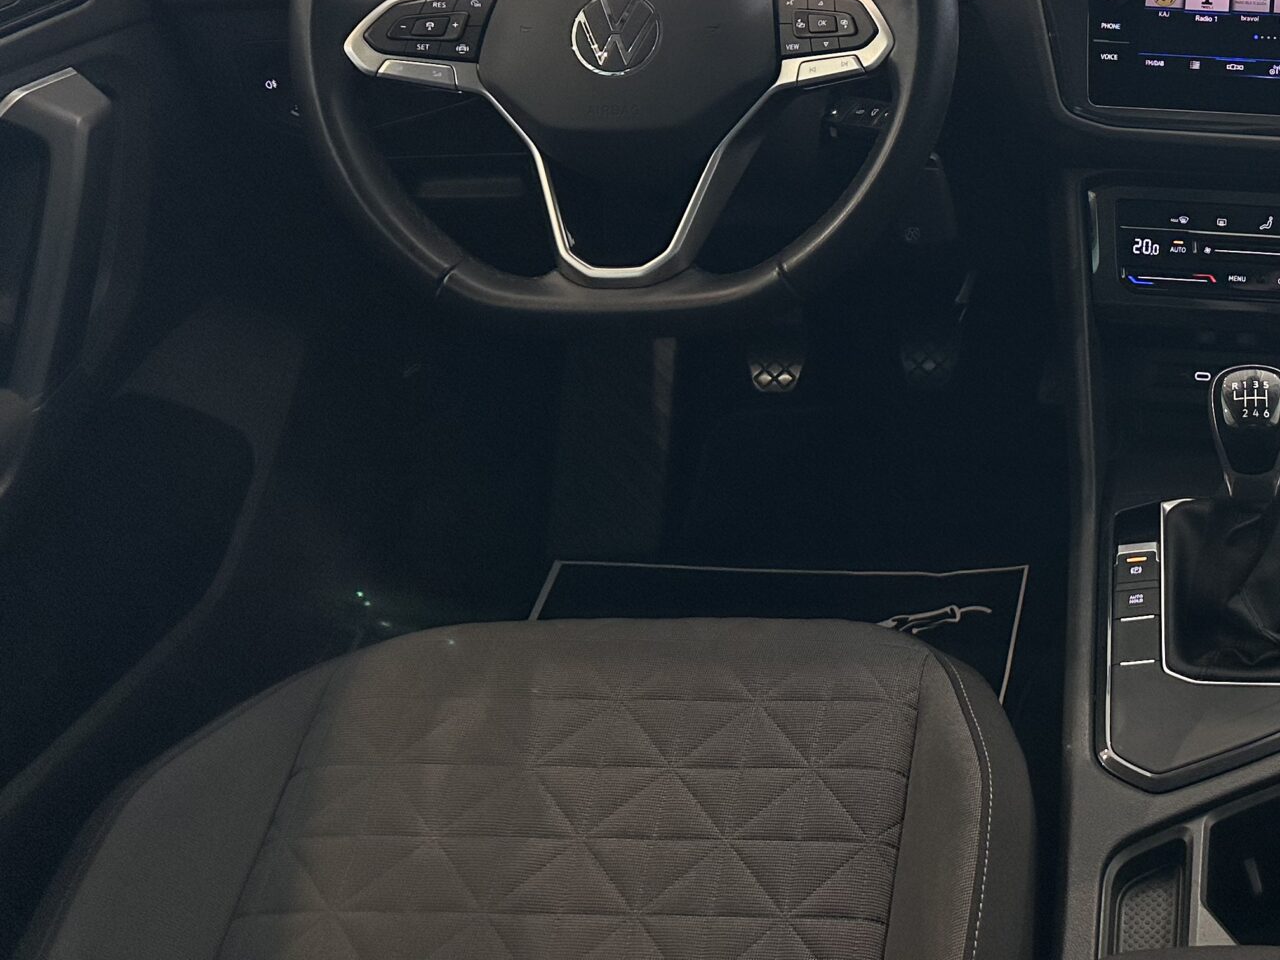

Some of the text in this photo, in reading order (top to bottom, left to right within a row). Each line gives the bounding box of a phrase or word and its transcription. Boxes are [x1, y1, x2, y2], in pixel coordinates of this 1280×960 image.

[432, 1, 447, 9] RES
[1195, 15, 1213, 23] Radio
[1101, 22, 1121, 30] PHONE
[416, 43, 430, 51] SET
[785, 43, 800, 51] VIEW
[1100, 53, 1119, 61] VOICE
[1132, 238, 1160, 256] 20.0
[1169, 246, 1187, 254] AUTO
[1228, 275, 1247, 283] MENU
[1231, 382, 1239, 390] R
[1252, 380, 1259, 389] 3
[1263, 380, 1270, 389] 5
[1242, 408, 1270, 418] 2 4 6
